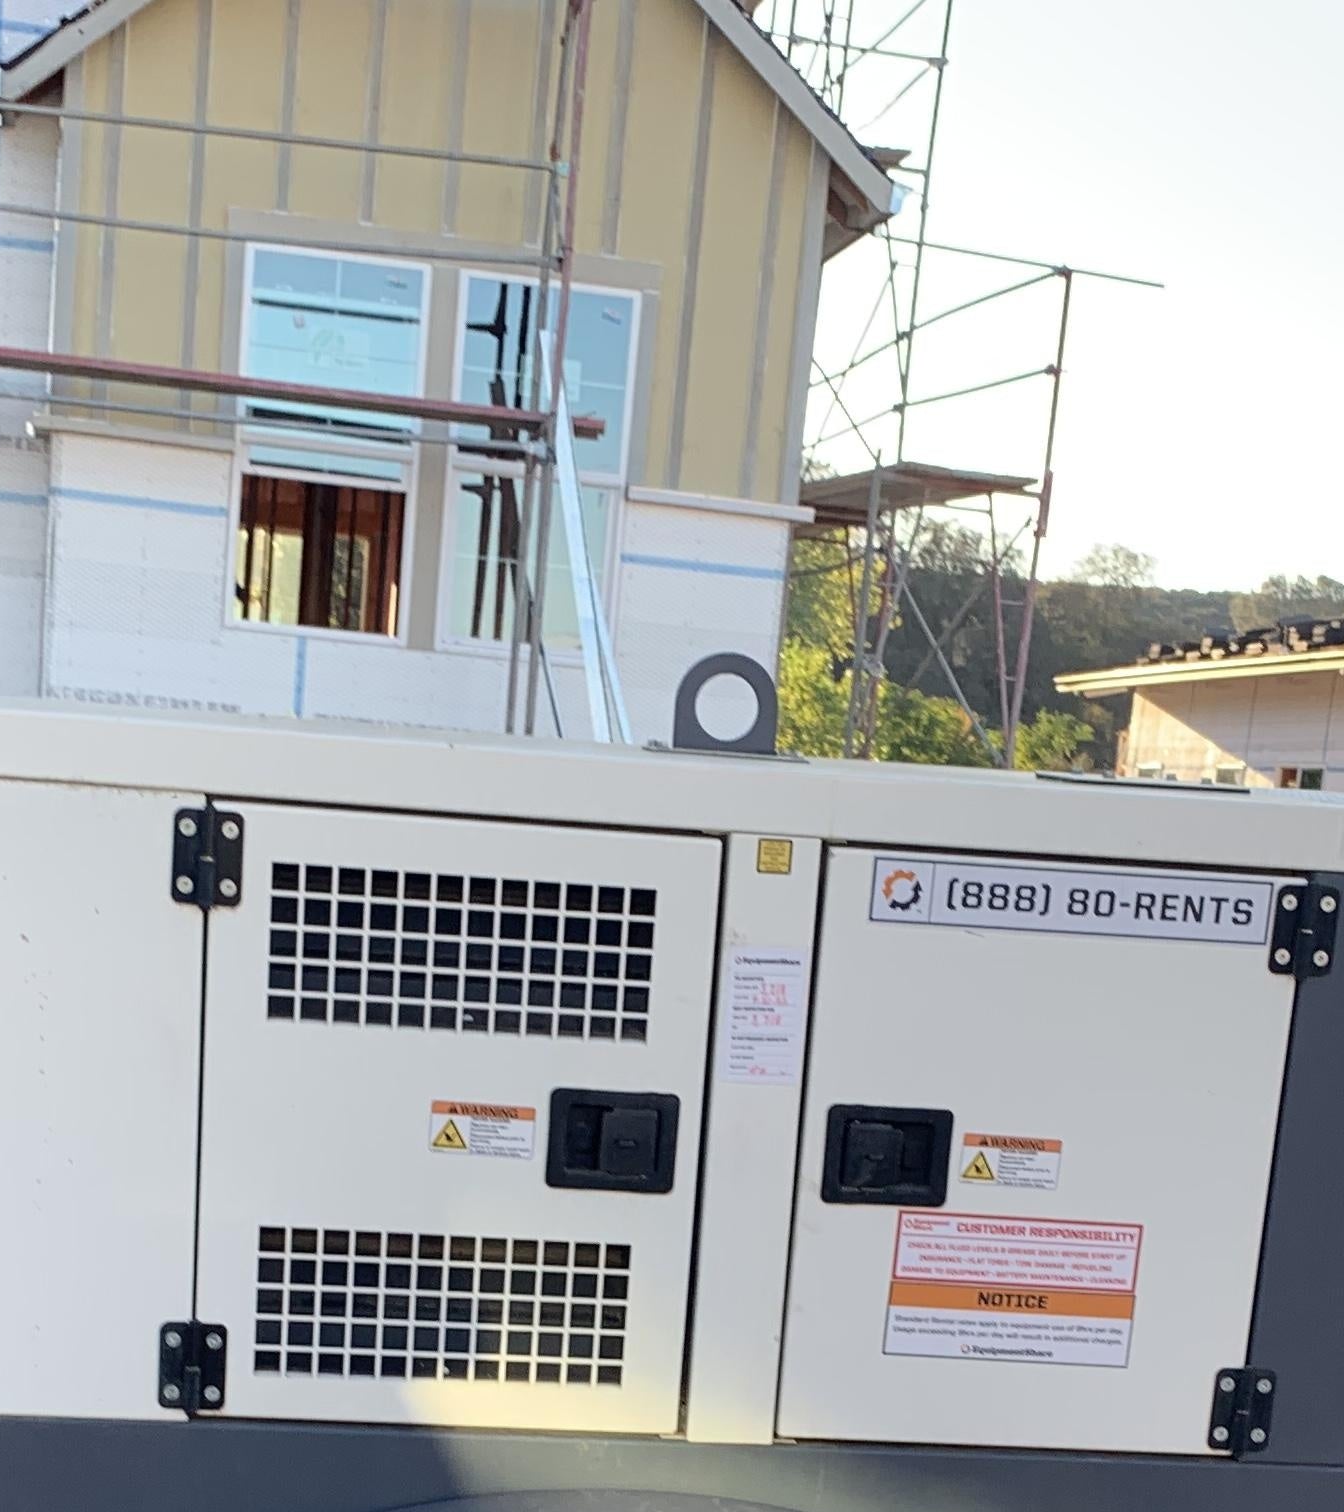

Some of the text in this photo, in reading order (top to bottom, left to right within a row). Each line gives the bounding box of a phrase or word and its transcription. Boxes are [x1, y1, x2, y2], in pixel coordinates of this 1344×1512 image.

[947, 878, 1256, 927] (888) 80-RENTS
[956, 1222, 1136, 1243] CUSTOMER RESPONSIBILITY
[976, 1291, 1049, 1310] NOTICE
